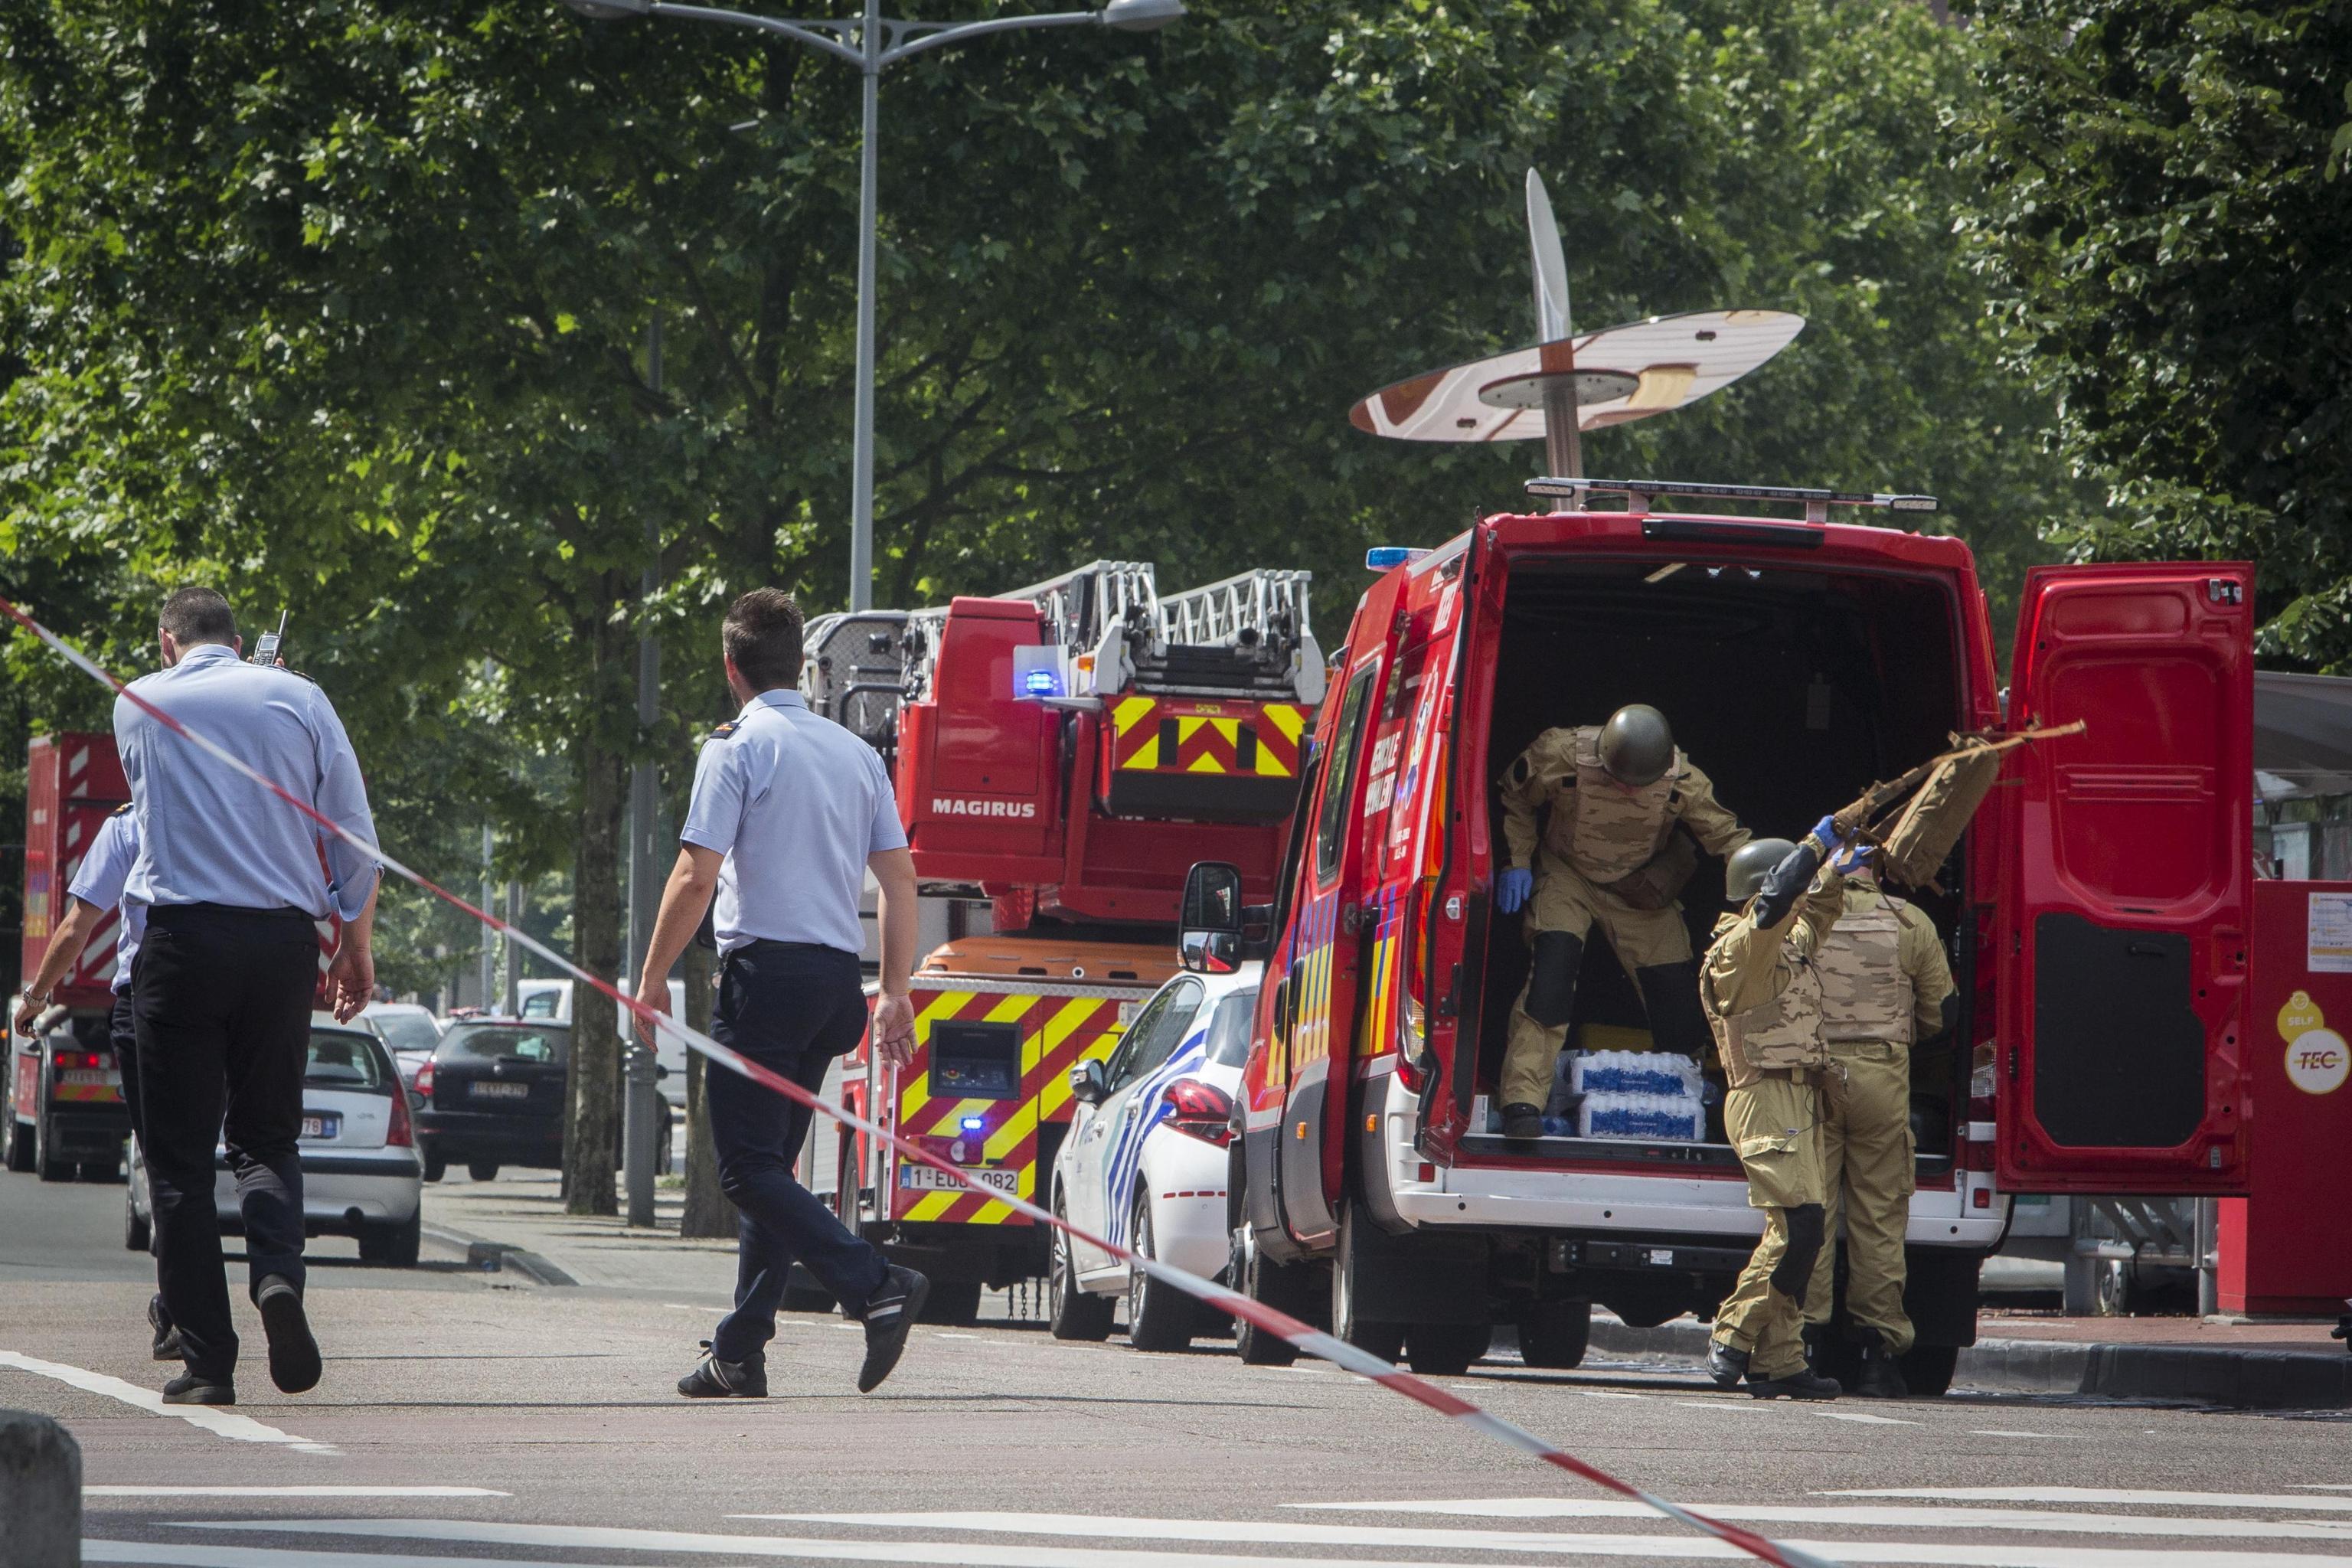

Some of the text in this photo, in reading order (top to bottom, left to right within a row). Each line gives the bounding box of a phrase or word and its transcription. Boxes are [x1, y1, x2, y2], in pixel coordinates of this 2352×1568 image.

[933, 799, 1035, 818] MAGIRUS
[2288, 1017, 2314, 1026] SELF
[2300, 1051, 2337, 1070] TEC
